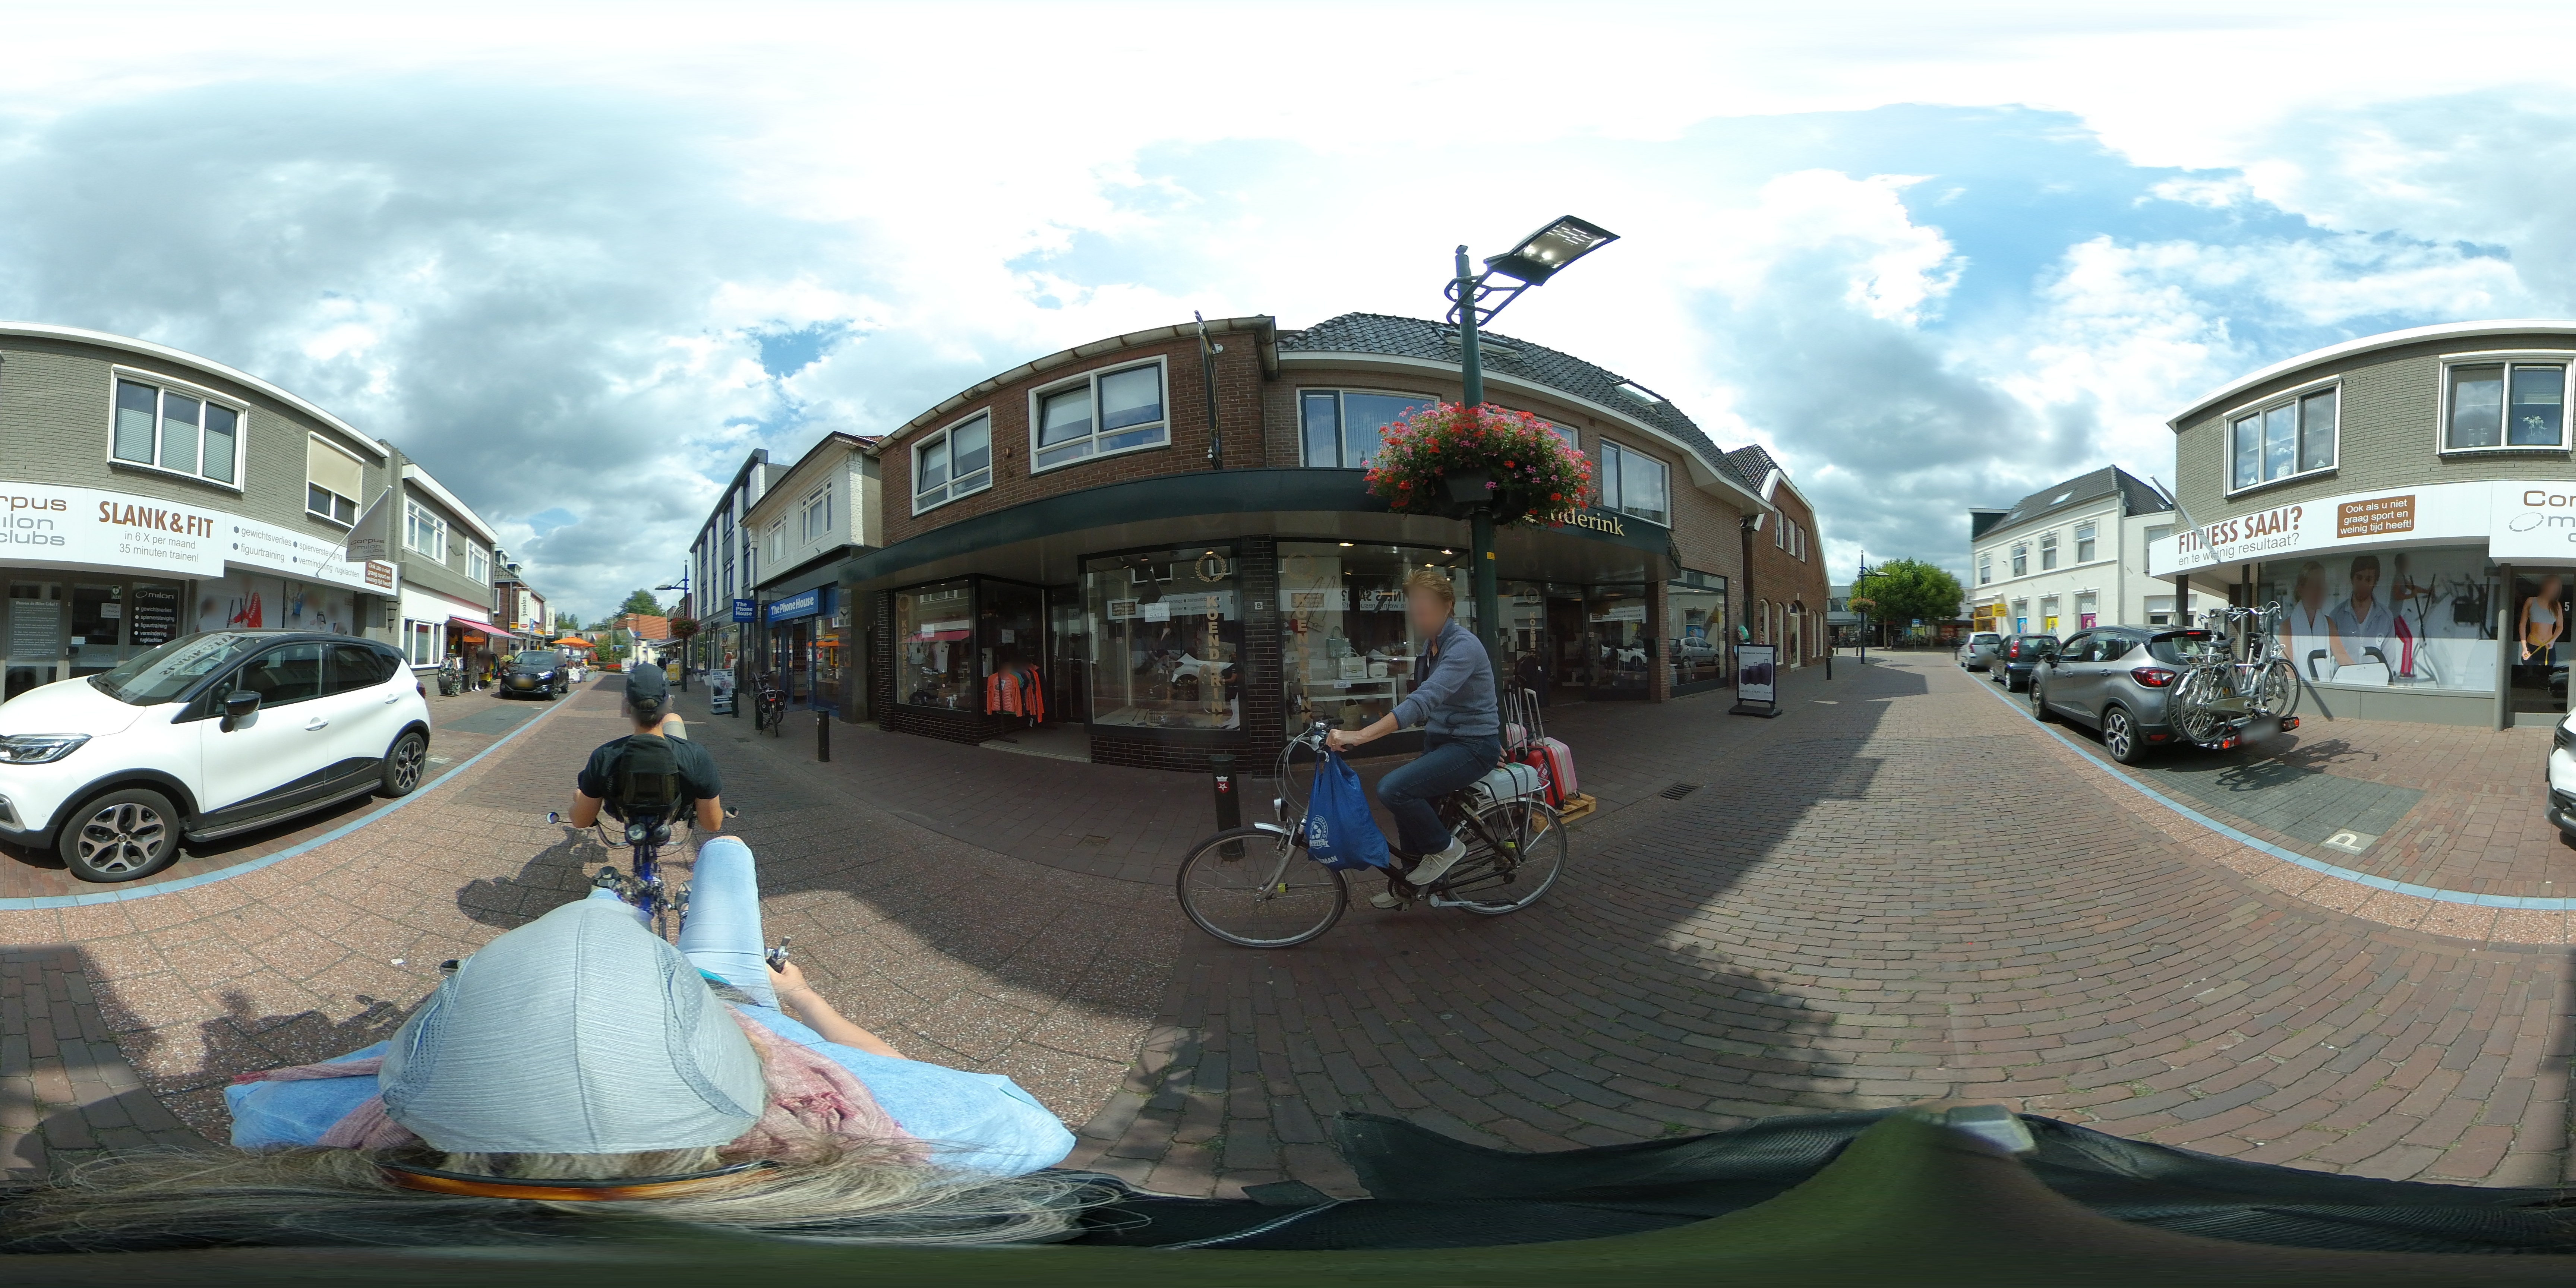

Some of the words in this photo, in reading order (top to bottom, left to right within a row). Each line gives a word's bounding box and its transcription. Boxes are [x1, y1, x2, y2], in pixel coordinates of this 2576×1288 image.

[2346, 504, 2364, 513] Ook
[2366, 502, 2379, 511] als
[2390, 499, 2407, 508] niet
[2245, 506, 2302, 539] SAAI?
[2340, 524, 2367, 534] weinig
[2370, 522, 2383, 533] tijd
[2386, 519, 2412, 530] heeft!
[2344, 515, 2368, 525] graag
[2371, 511, 2394, 521] sport
[125, 531, 132, 540] in
[135, 532, 141, 541] 6
[143, 533, 150, 542] X
[152, 537, 166, 545] per
[168, 539, 195, 549] maand
[242, 528, 291, 546] gewichtsverlies
[119, 543, 130, 553] 35
[133, 546, 167, 558] minuten
[170, 550, 199, 562] trainen!
[241, 543, 284, 563] figuurtraining
[299, 543, 342, 561] spierversteviging
[2179, 557, 2189, 565] en
[2192, 553, 2200, 563] te
[2239, 533, 2299, 554] resultaat?
[299, 558, 332, 573] vermindering
[335, 566, 359, 578] rugklachten
[771, 606, 780, 615] The
[780, 603, 795, 613] Phone
[796, 596, 814, 609] House
[2564, 602, 2570, 611] 5
[2326, 833, 2361, 851] P
